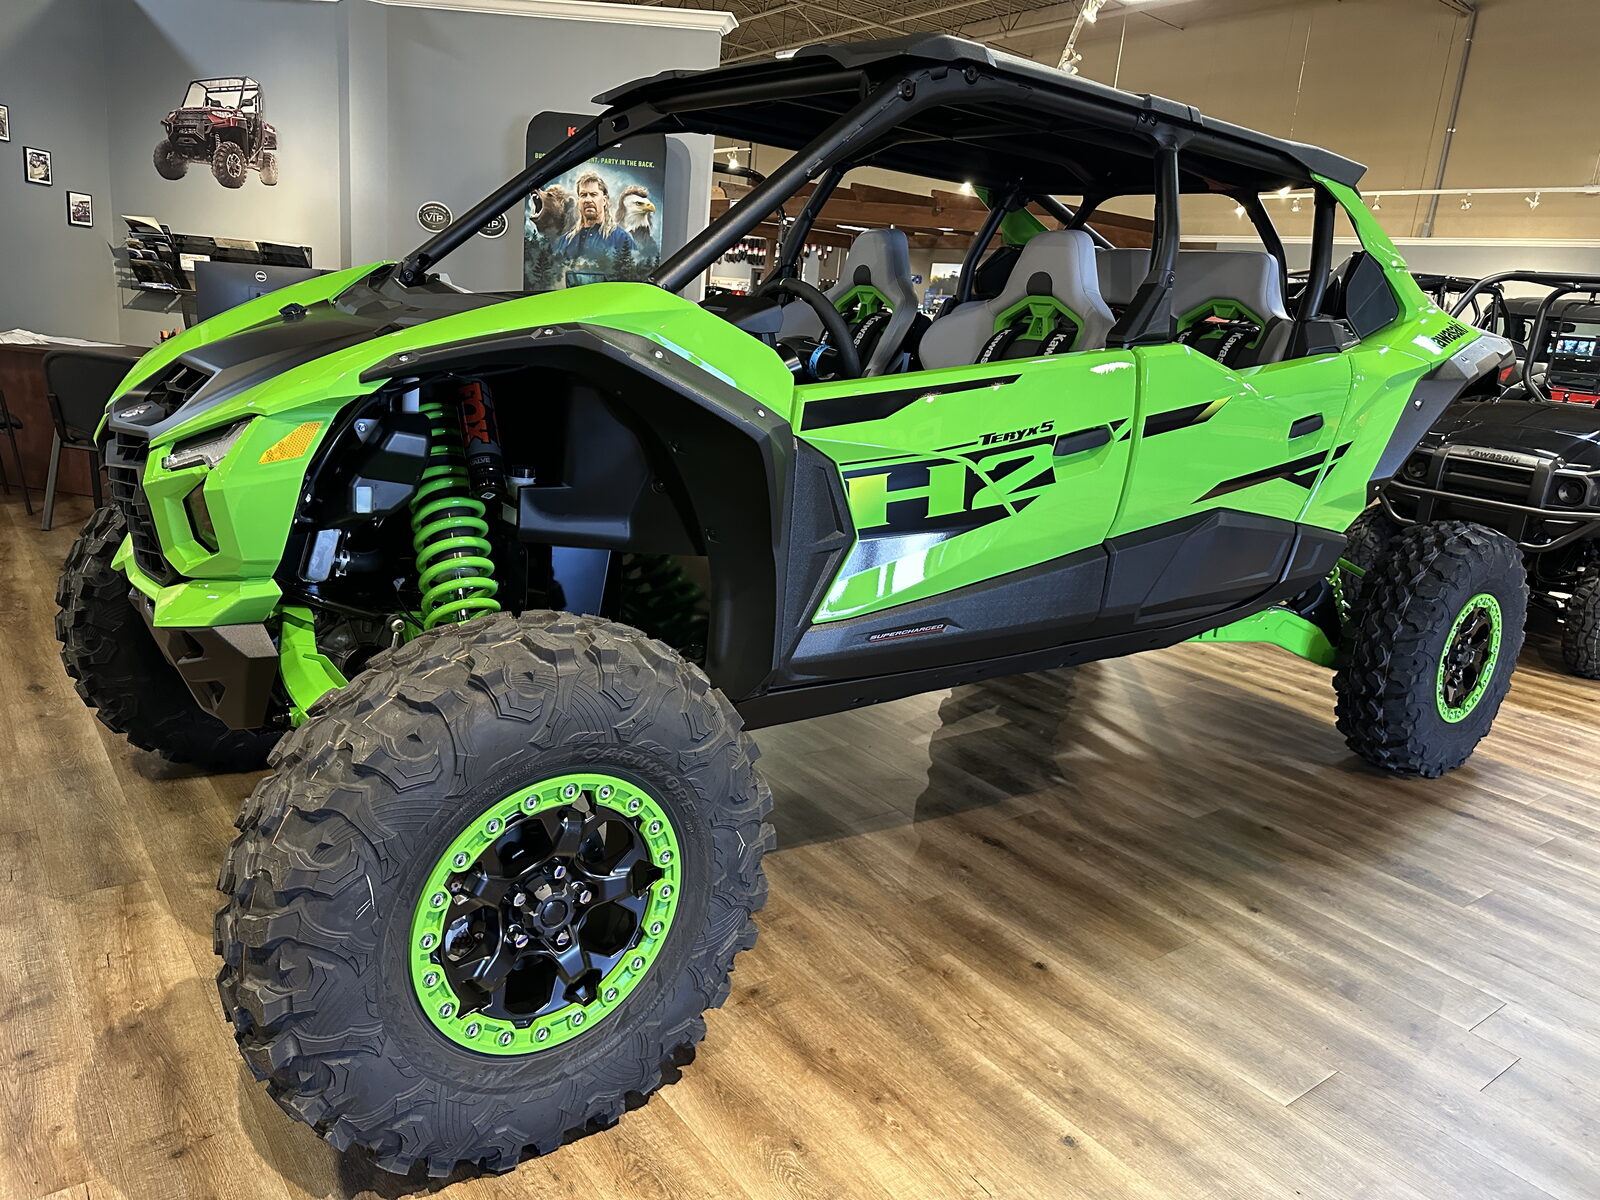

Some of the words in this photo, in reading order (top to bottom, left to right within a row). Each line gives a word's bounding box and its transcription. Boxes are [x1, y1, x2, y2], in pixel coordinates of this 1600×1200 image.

[601, 157, 619, 165] PARTY
[638, 160, 655, 168] BACK.
[425, 213, 444, 222] VIP
[853, 315, 882, 350] Kawas
[980, 328, 1012, 364] Kawas
[1431, 320, 1469, 349] awasaki
[1216, 332, 1244, 364] Kawas
[460, 382, 490, 443] FOX
[1467, 448, 1519, 463] Kawasaki
[845, 443, 1054, 530] H2
[869, 623, 944, 640] SUPERCHARGED
